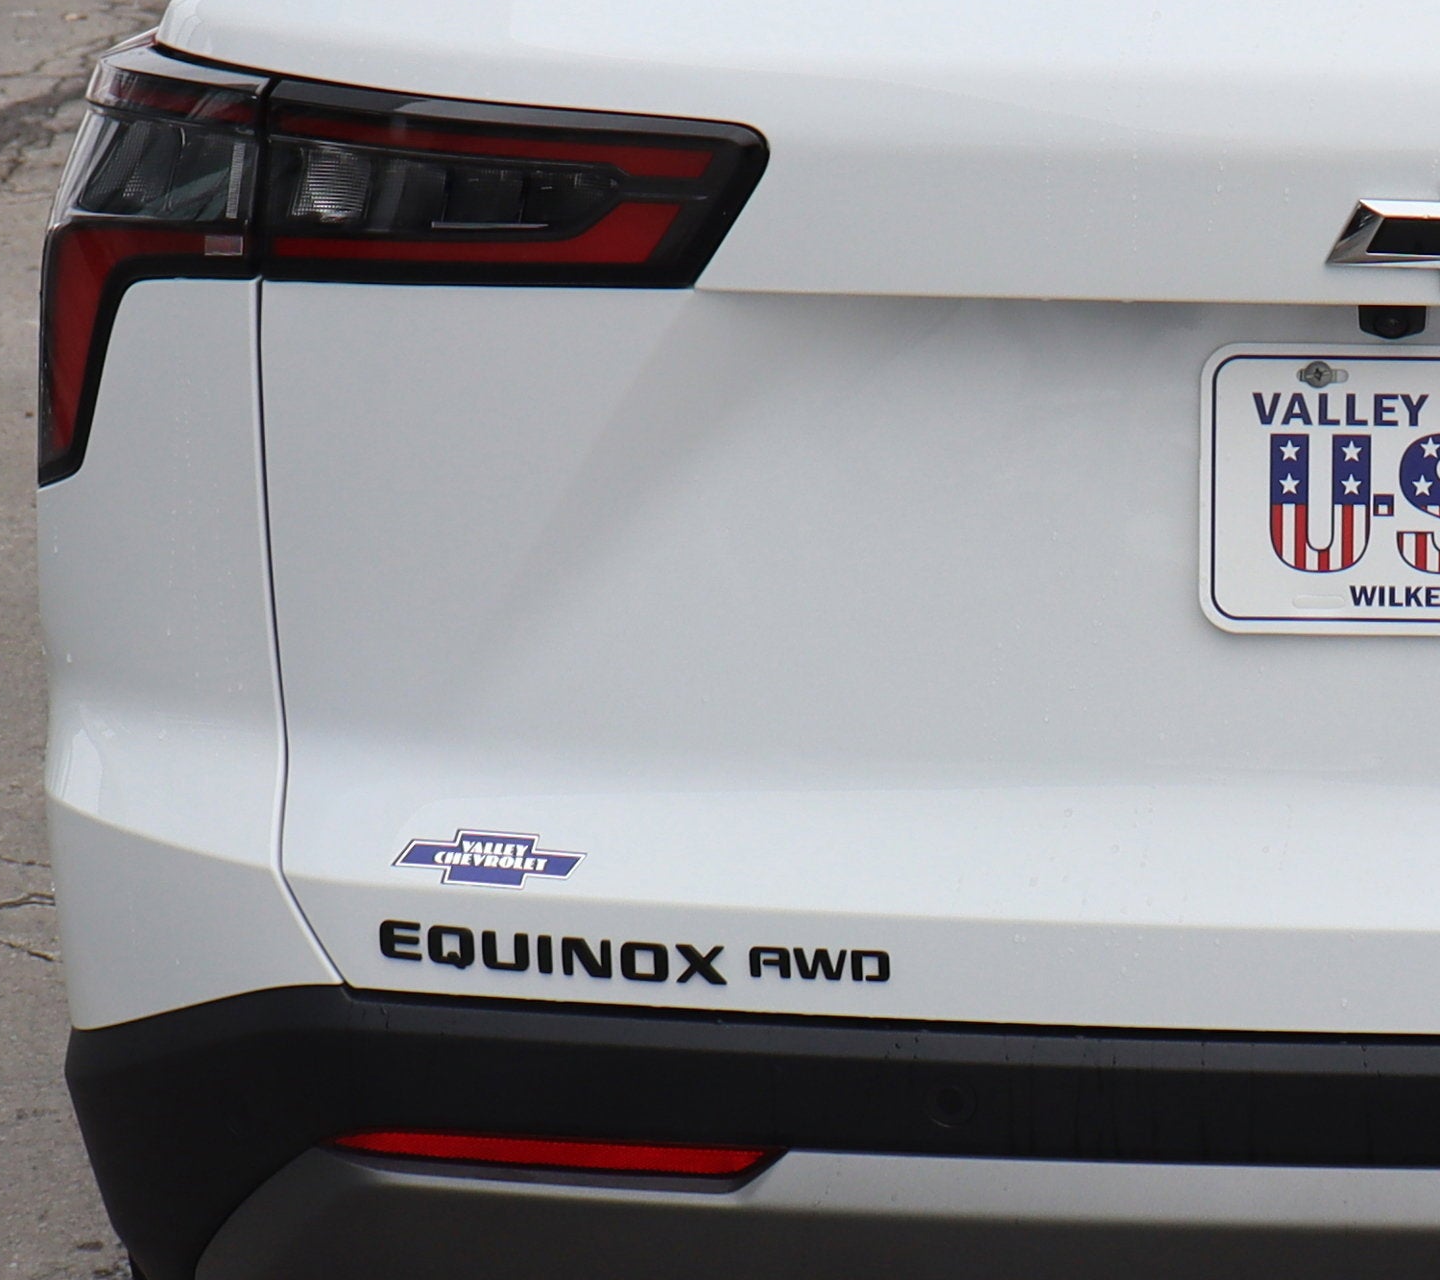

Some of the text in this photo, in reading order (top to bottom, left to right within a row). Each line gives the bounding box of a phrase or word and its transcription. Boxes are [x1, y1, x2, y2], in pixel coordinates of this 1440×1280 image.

[1252, 392, 1429, 427] VALLEY
[433, 850, 548, 871] CHEVROLET
[461, 839, 529, 856] VALLEY
[378, 919, 891, 985] EQUINOX AWD
